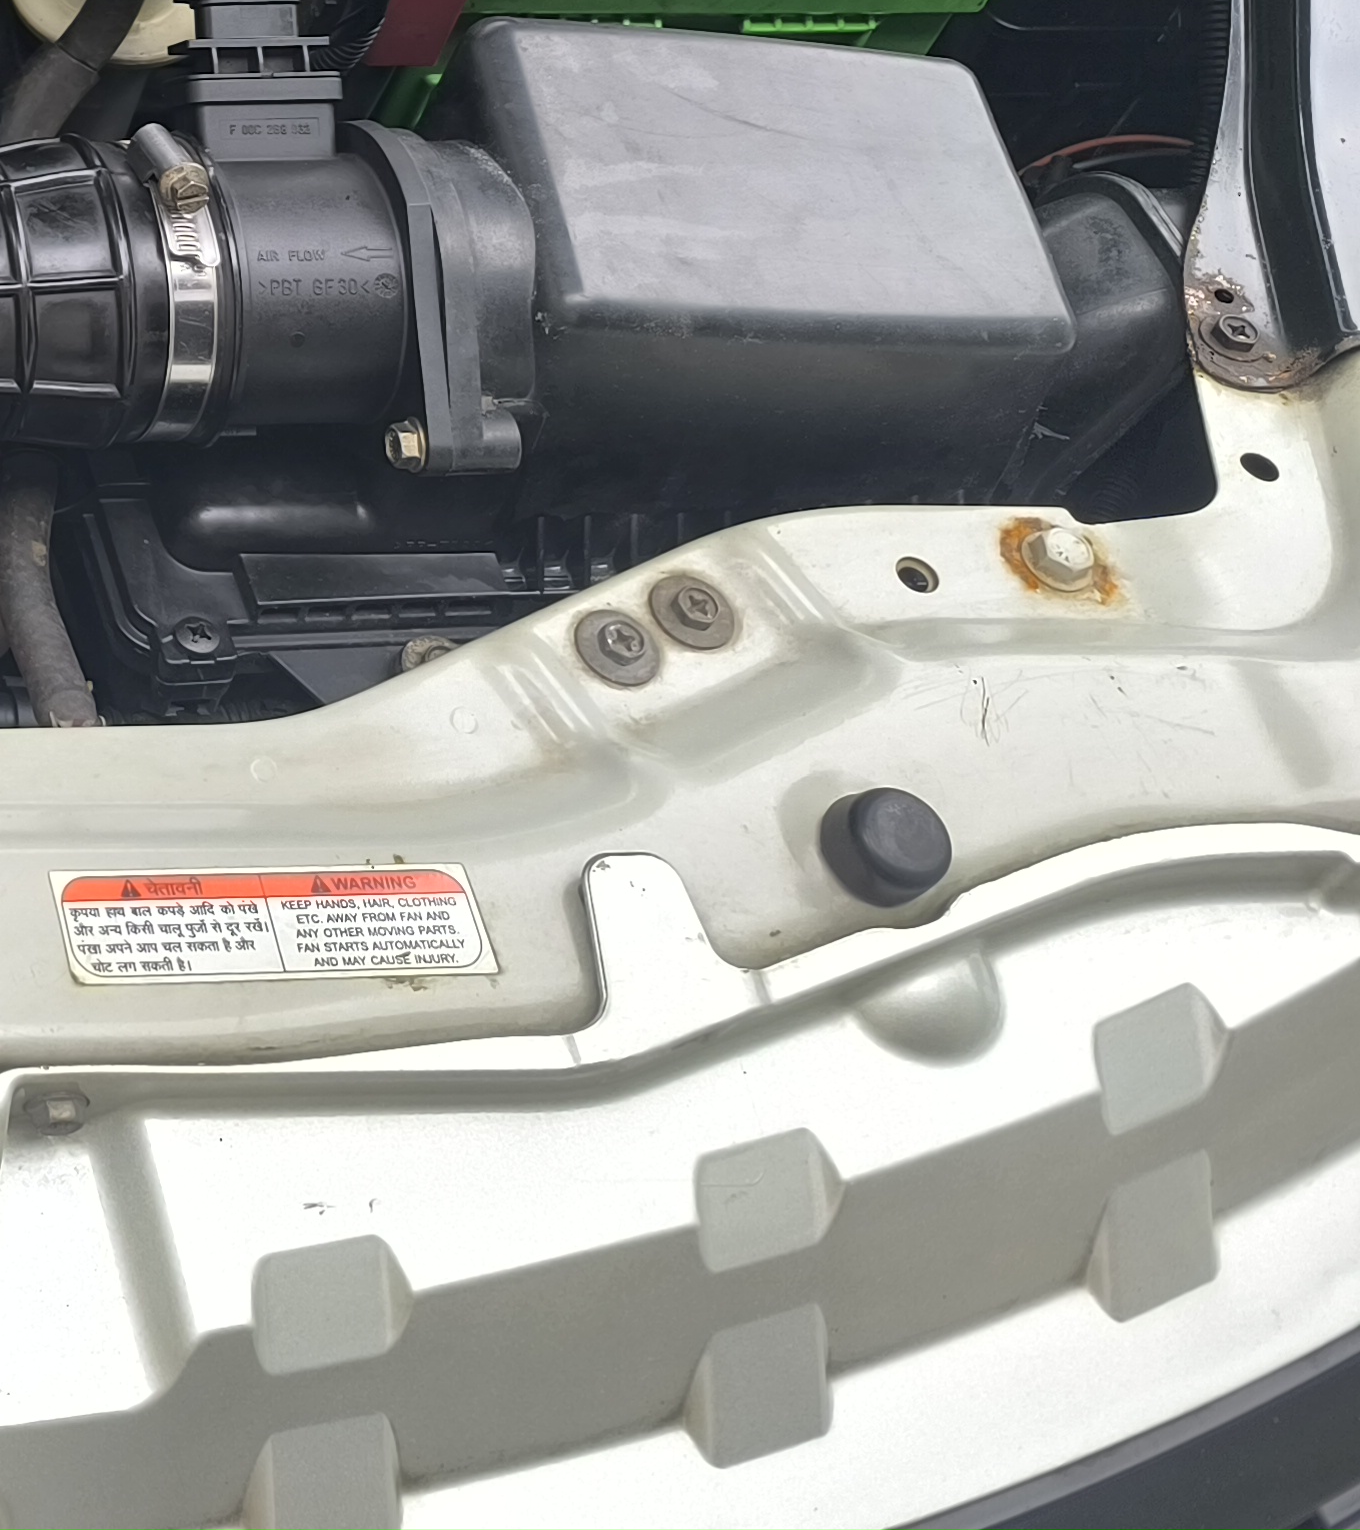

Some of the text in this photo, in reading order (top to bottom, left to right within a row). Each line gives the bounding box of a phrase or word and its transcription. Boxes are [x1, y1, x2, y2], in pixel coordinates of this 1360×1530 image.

[257, 250, 326, 262] AIR FLOW
[144, 877, 203, 896] चेतावनी
[330, 875, 416, 891] WARNING
[190, 901, 215, 916] आदि
[280, 896, 457, 910] KEEP HANDS, HAIR, CLOTHING
[296, 910, 450, 924] ETC. AWAY FROM FAN AND
[125, 920, 155, 935] किसी
[296, 925, 460, 939] ANY OTHER MOVING PARTS.
[105, 938, 133, 954] अपने
[136, 942, 158, 954] आप
[235, 936, 256, 951] और
[297, 939, 465, 953] FAN STARTS AUTOMATICALLY
[314, 953, 459, 967] AND MAY CAUSE INJURY.
